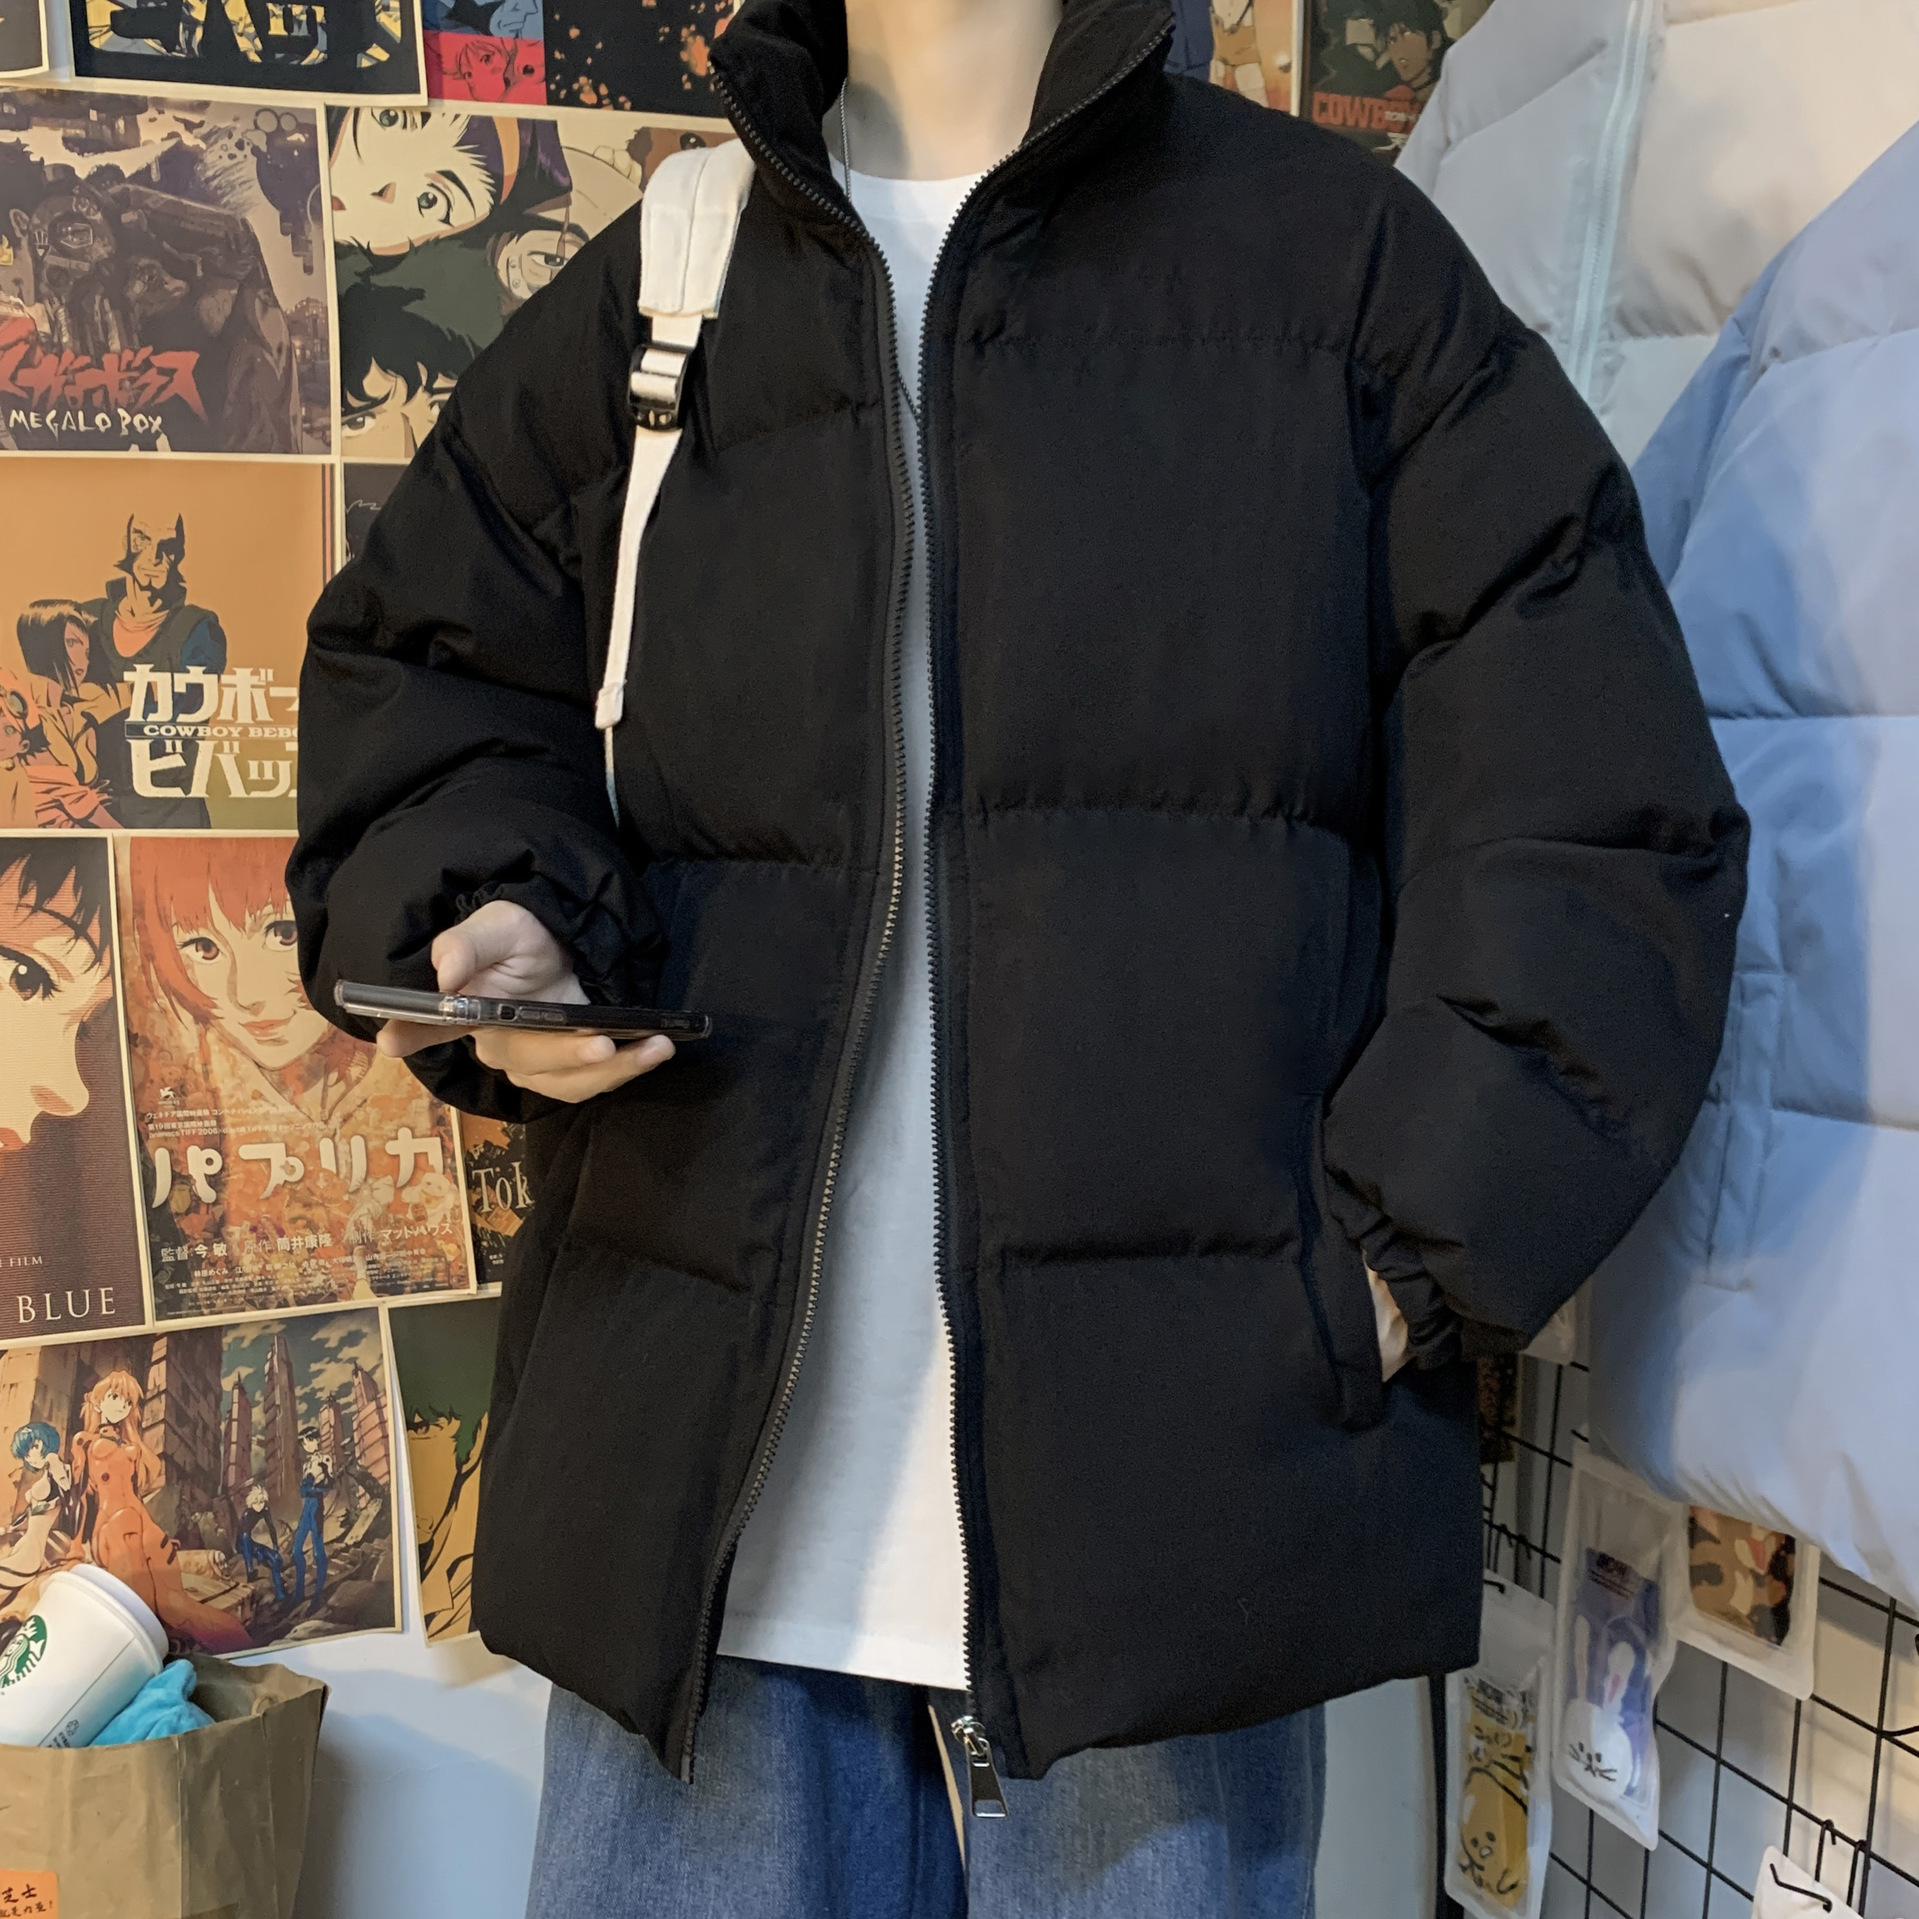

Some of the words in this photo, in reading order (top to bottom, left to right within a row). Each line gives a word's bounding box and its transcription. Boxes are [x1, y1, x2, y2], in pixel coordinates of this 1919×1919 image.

[123, 663, 299, 724] カウボー
[143, 724, 243, 738] COWBOY
[152, 1126, 444, 1209] パプリカ
[9, 1256, 43, 1267] FILM
[16, 1286, 116, 1324] BLUE
